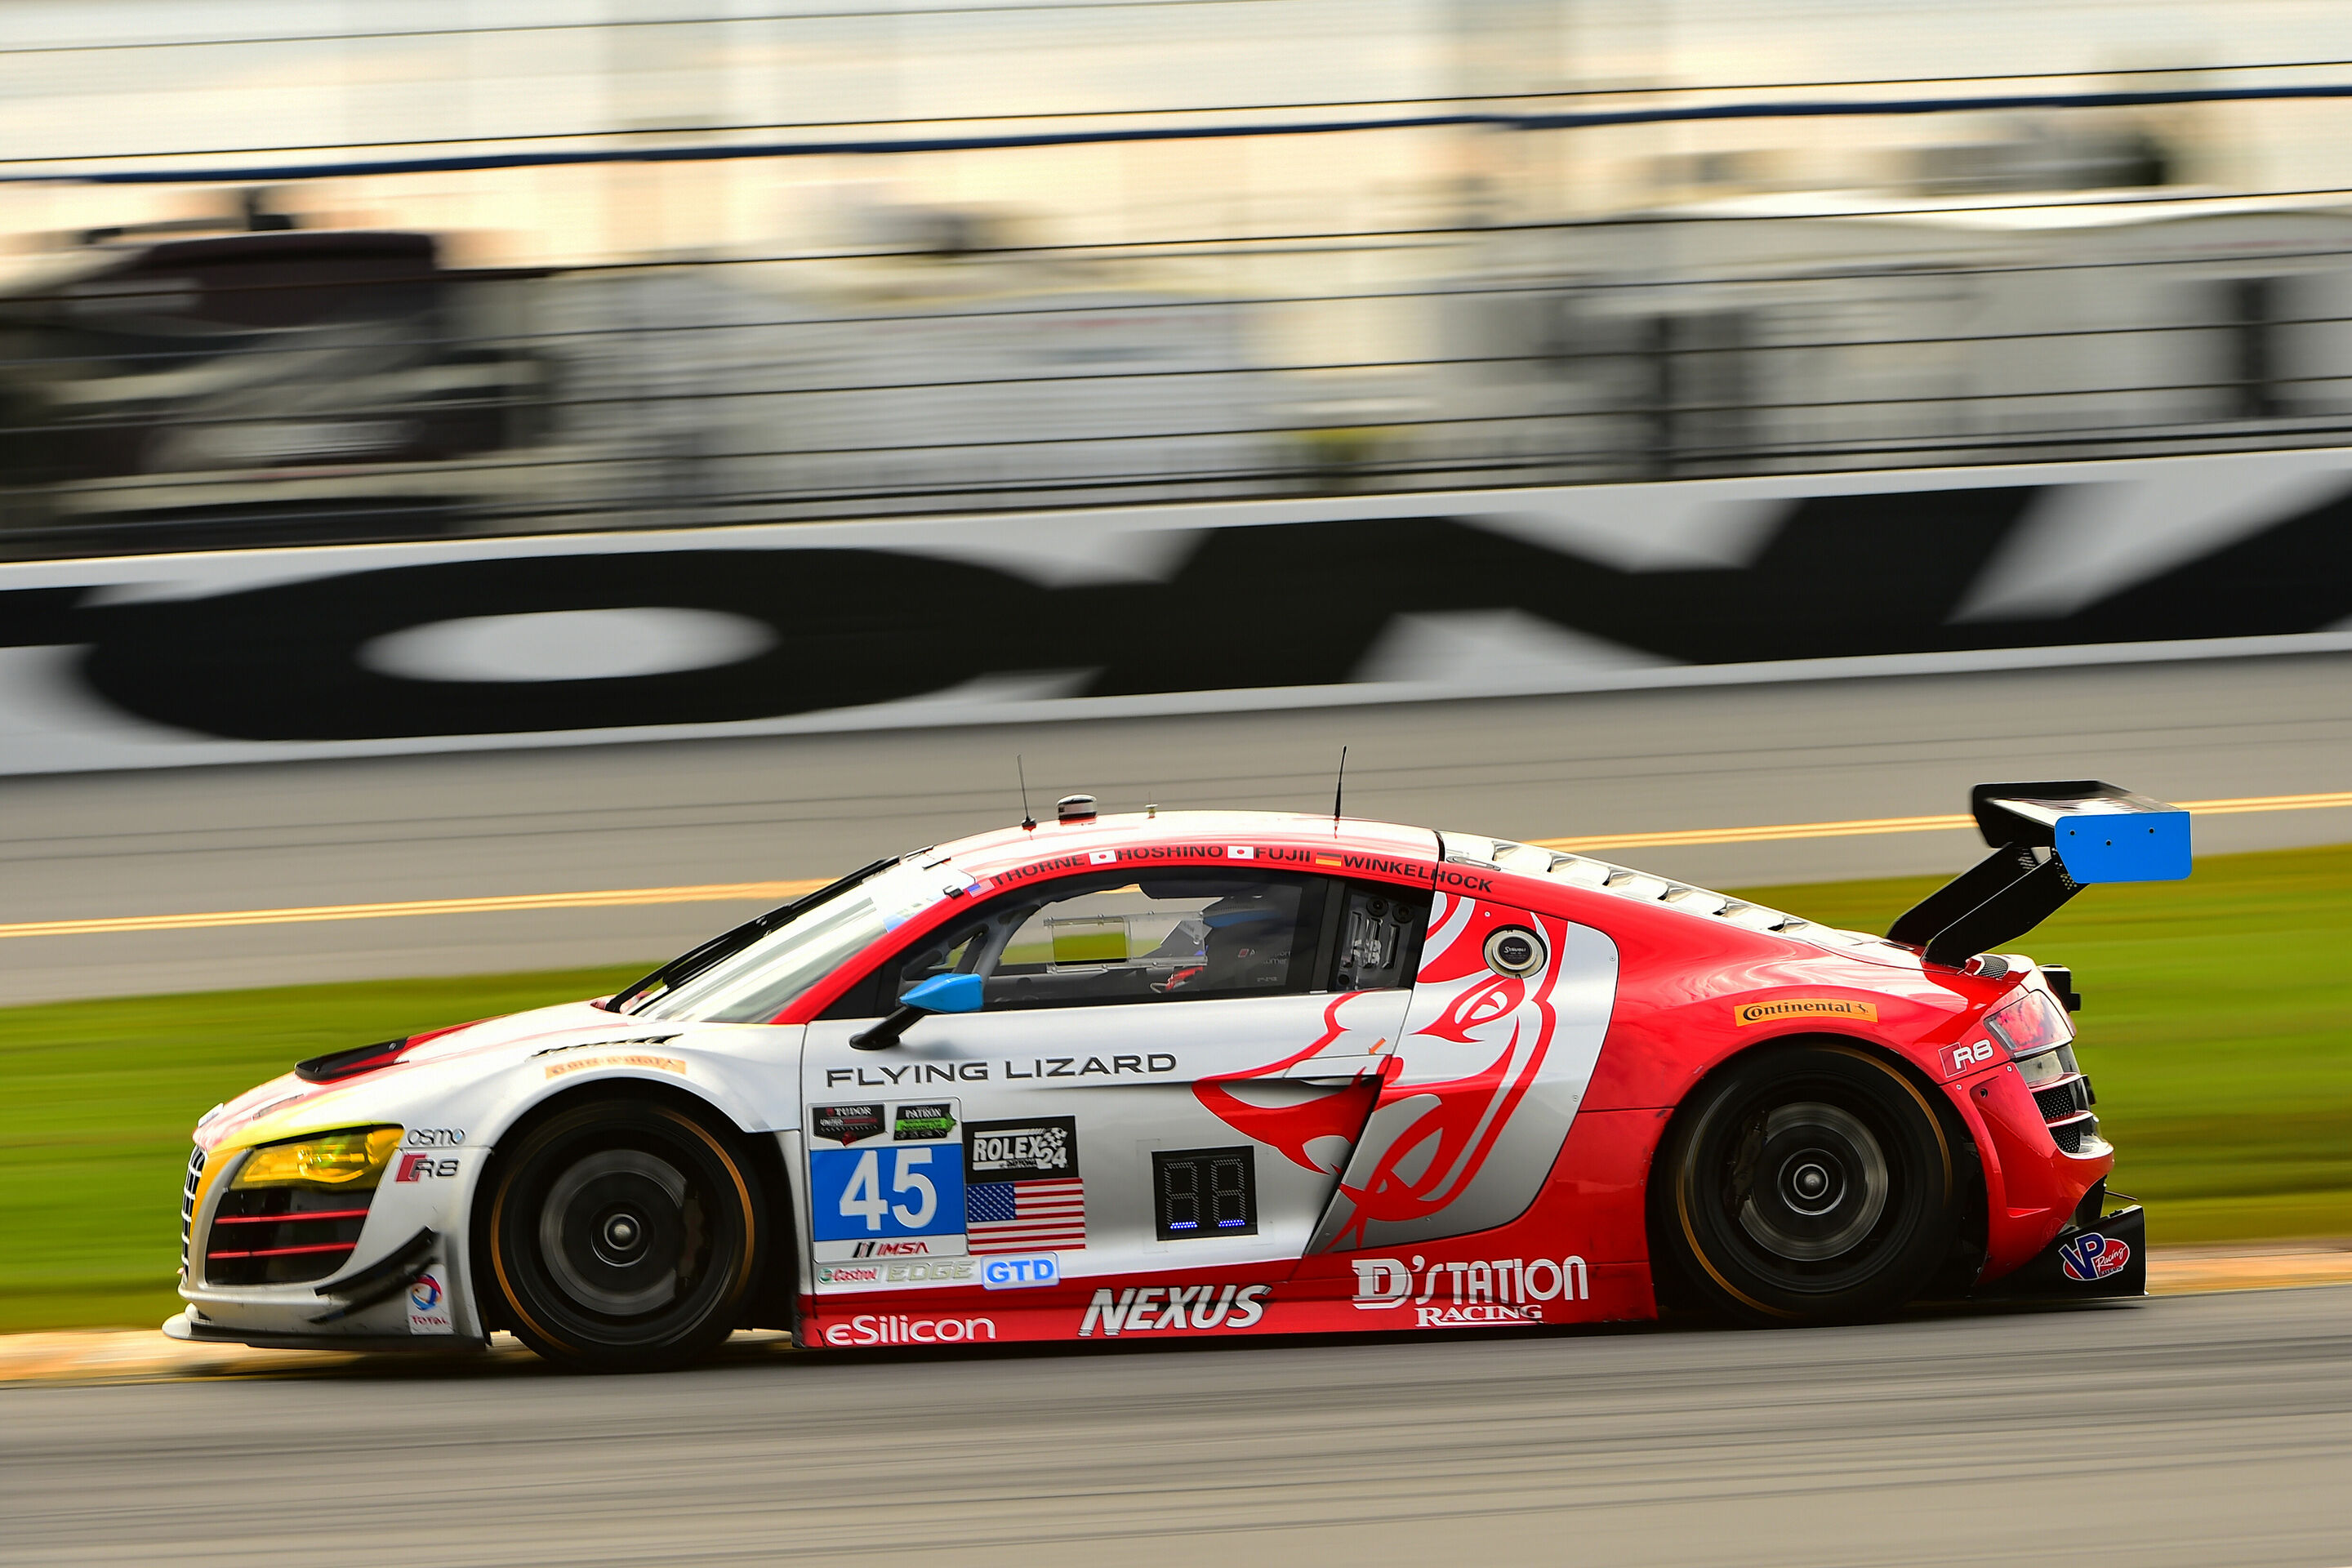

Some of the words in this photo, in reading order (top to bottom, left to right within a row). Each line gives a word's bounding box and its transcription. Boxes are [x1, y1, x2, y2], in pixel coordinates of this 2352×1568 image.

[991, 854, 1085, 886] THORNE
[1116, 845, 1223, 861] HOSHINO
[1254, 847, 1311, 862] FUJII
[1343, 854, 1494, 893] WINKELHOCK
[1742, 1001, 1851, 1021] Continental
[1953, 1039, 1993, 1070] R8
[826, 1061, 989, 1088] FLYING
[1005, 1052, 1178, 1080] LIZARD
[973, 1135, 1044, 1161] ROLEX
[1036, 1147, 1067, 1169] 24
[408, 1158, 460, 1181] R8
[840, 1147, 938, 1231] 45
[877, 1241, 929, 1256] IMSA
[2058, 1232, 2106, 1281] VP
[2096, 1245, 2127, 1272] Racing
[834, 1267, 878, 1281] Castrol
[887, 1260, 976, 1282] EDGE
[986, 1258, 1054, 1285] GTD
[411, 1315, 451, 1325] TOTAL
[1078, 1285, 1272, 1338] NEXUS
[1414, 1304, 1543, 1328] RACING
[826, 1314, 996, 1347] eSilicon
